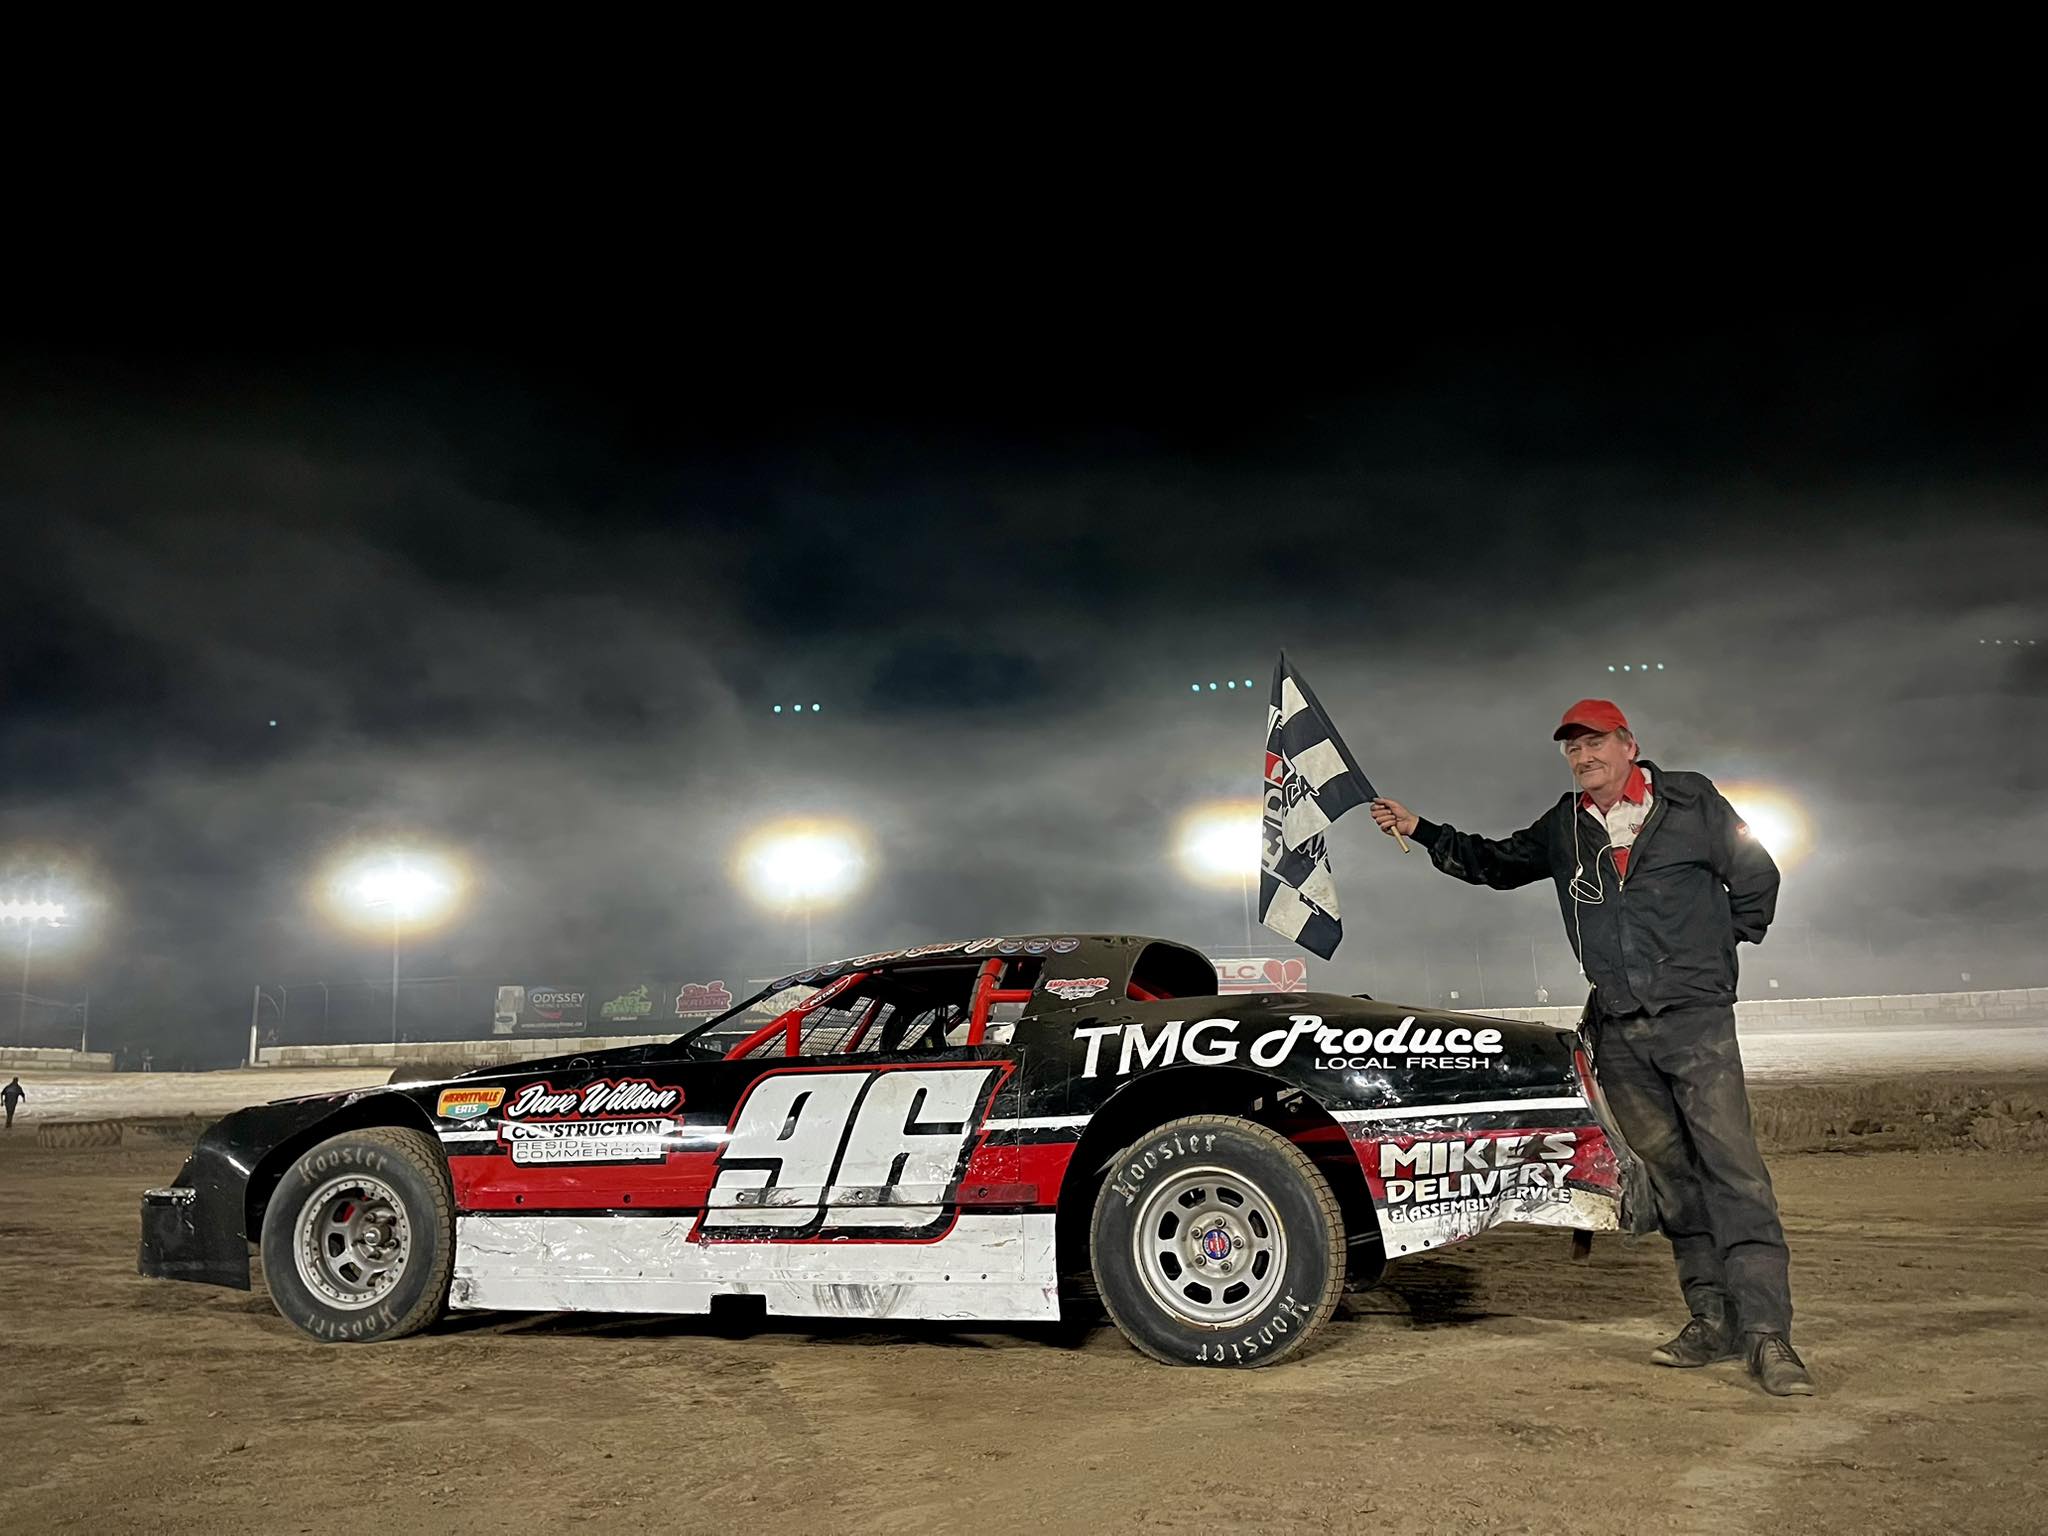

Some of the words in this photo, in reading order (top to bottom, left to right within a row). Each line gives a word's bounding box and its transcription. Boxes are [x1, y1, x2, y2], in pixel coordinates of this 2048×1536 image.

[532, 992, 585, 1004] ODYSSEY
[1073, 1018, 1240, 1079] TMG
[1250, 1015, 1503, 1069] Produce
[1314, 1056, 1397, 1071] LOCAL
[1406, 1056, 1490, 1070] FRESH
[442, 1091, 501, 1103] MERRITTVILLE
[455, 1104, 479, 1114] EATS
[508, 1085, 578, 1117] Dave
[578, 1082, 677, 1114] Willson
[512, 1120, 662, 1140] CONSTRUCTION
[700, 1067, 995, 1229] 96
[298, 1146, 388, 1185] Hoosier
[1111, 1131, 1217, 1207] Hoosier
[1380, 1131, 1577, 1178] MIKE'S
[1385, 1162, 1574, 1204] DELIVERY
[1409, 1197, 1496, 1222] ASSEMBLY
[1195, 1288, 1312, 1364] Hoosier
